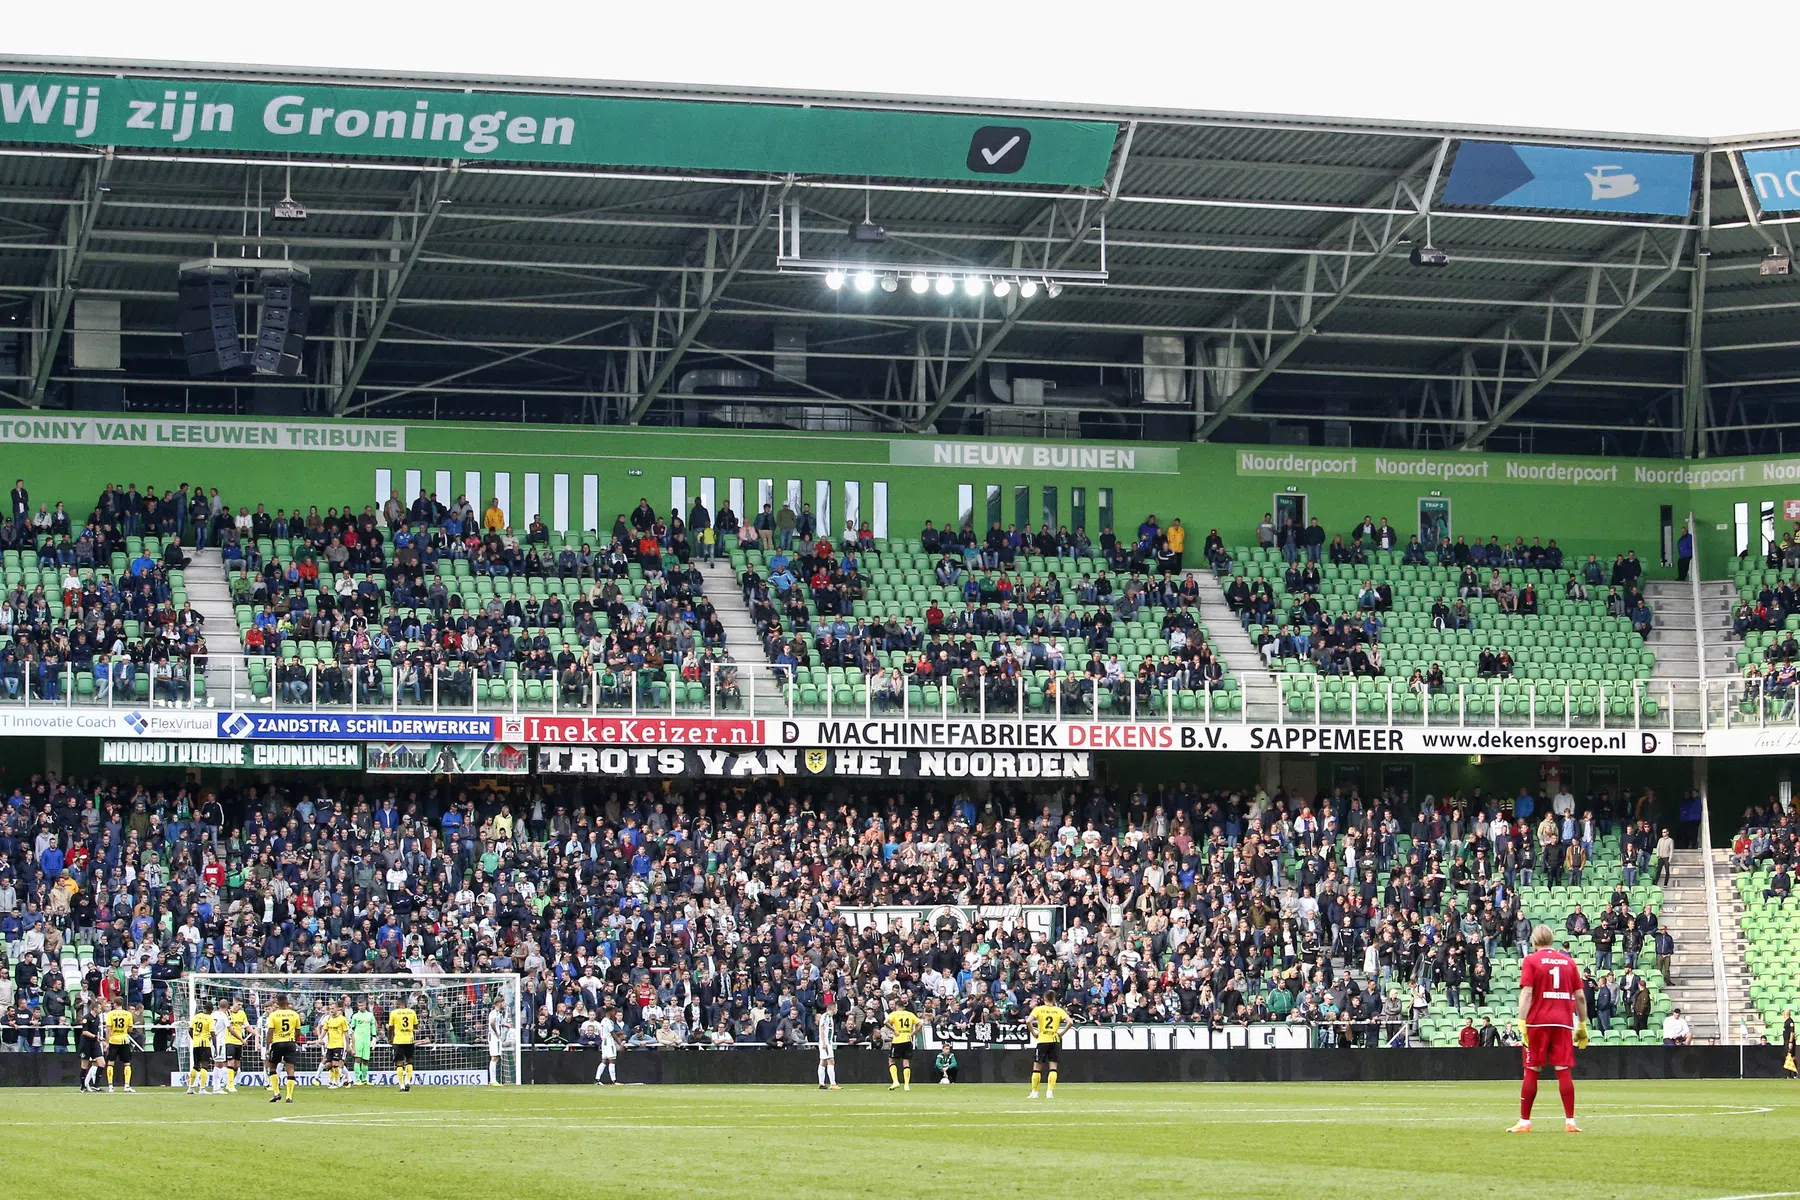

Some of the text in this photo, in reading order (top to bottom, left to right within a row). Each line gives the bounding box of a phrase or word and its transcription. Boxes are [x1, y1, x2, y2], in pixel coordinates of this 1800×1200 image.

[0, 83, 576, 154] Wij zijn Groningen
[0, 421, 398, 449] TONNY VAN LEEUWEN TRIBUNE
[933, 443, 1136, 470] NIEUW BUINEN
[1241, 453, 1357, 476] Noorderpoort
[1375, 457, 1489, 480] Noorderpoort
[1506, 462, 1618, 484] Noorderpoort
[1635, 465, 1746, 487] Noorderpoort
[12, 715, 73, 728] Innovatie
[77, 715, 116, 728] Coach
[151, 717, 212, 730] FlexVirtual
[257, 718, 490, 735] ZANDSTRA SCHILDERWERKEN
[530, 718, 760, 743] InekeKeizer.nl
[818, 721, 1404, 751] MACHINEFABRIEK DEKENS B.V. SAPPEMEER
[1422, 730, 1626, 753] www.dekensgroep.nl
[103, 741, 359, 766] NOORDTRIBUNE GRONINGEN
[540, 746, 1090, 778] TROTS VAN HET NOORDEN
[1549, 966, 1560, 989] 1
[113, 1018, 125, 1029] 13
[194, 1021, 203, 1033] 19
[281, 1018, 290, 1032] 5
[402, 1016, 409, 1028] 3
[899, 1018, 910, 1028] 14
[1045, 1016, 1054, 1029] 2
[360, 1073, 482, 1086] EACN LOGISTICS
